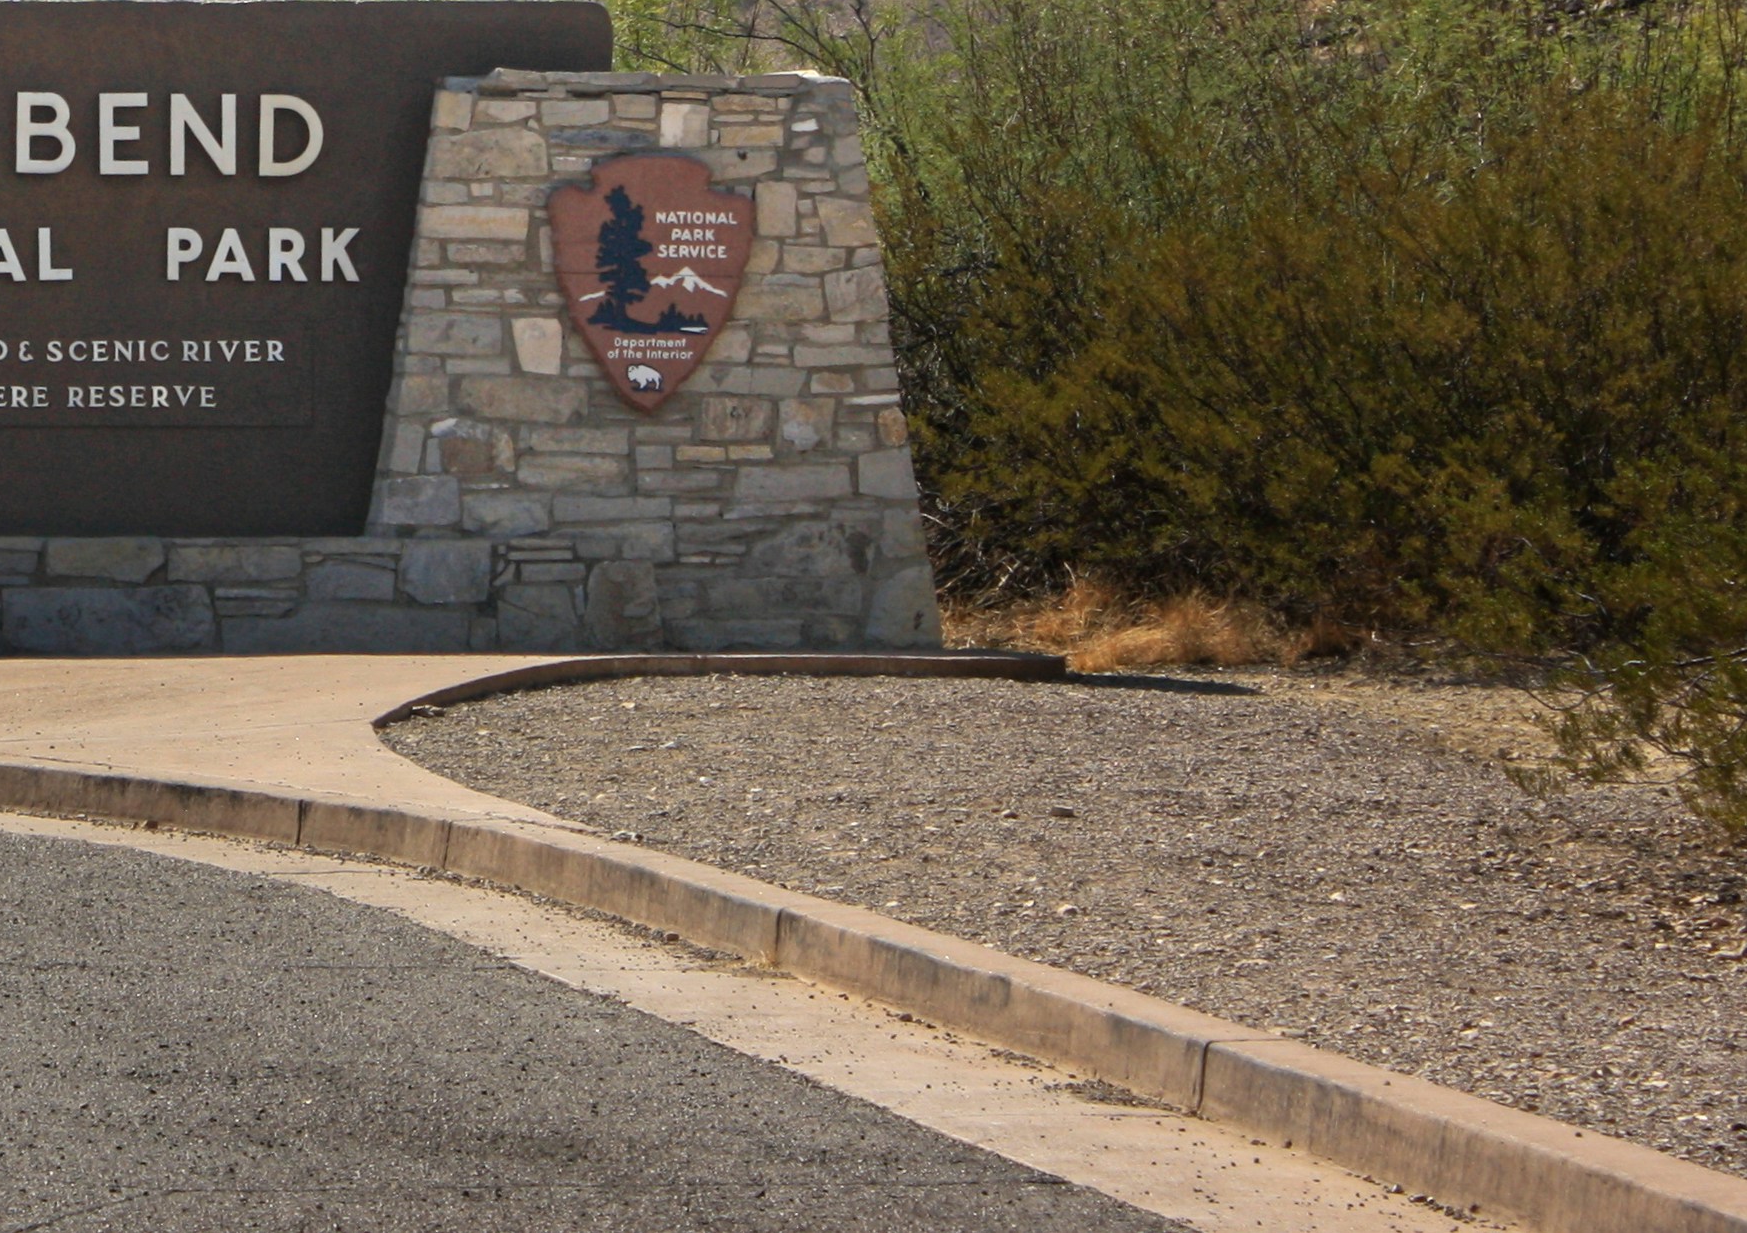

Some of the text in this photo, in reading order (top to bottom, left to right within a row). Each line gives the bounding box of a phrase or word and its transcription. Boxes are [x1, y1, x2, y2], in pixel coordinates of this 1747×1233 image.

[15, 91, 324, 177] BEND
[655, 211, 737, 225] NATIONAL
[671, 228, 715, 241] PARK
[166, 227, 361, 283] PARK
[657, 244, 727, 259] SERVICE
[614, 337, 687, 349] Department
[18, 340, 34, 362] &
[46, 340, 170, 362] SCENIC
[181, 340, 285, 362] RIVER
[607, 349, 694, 360] of the Interior
[67, 385, 217, 408] RESERVE
